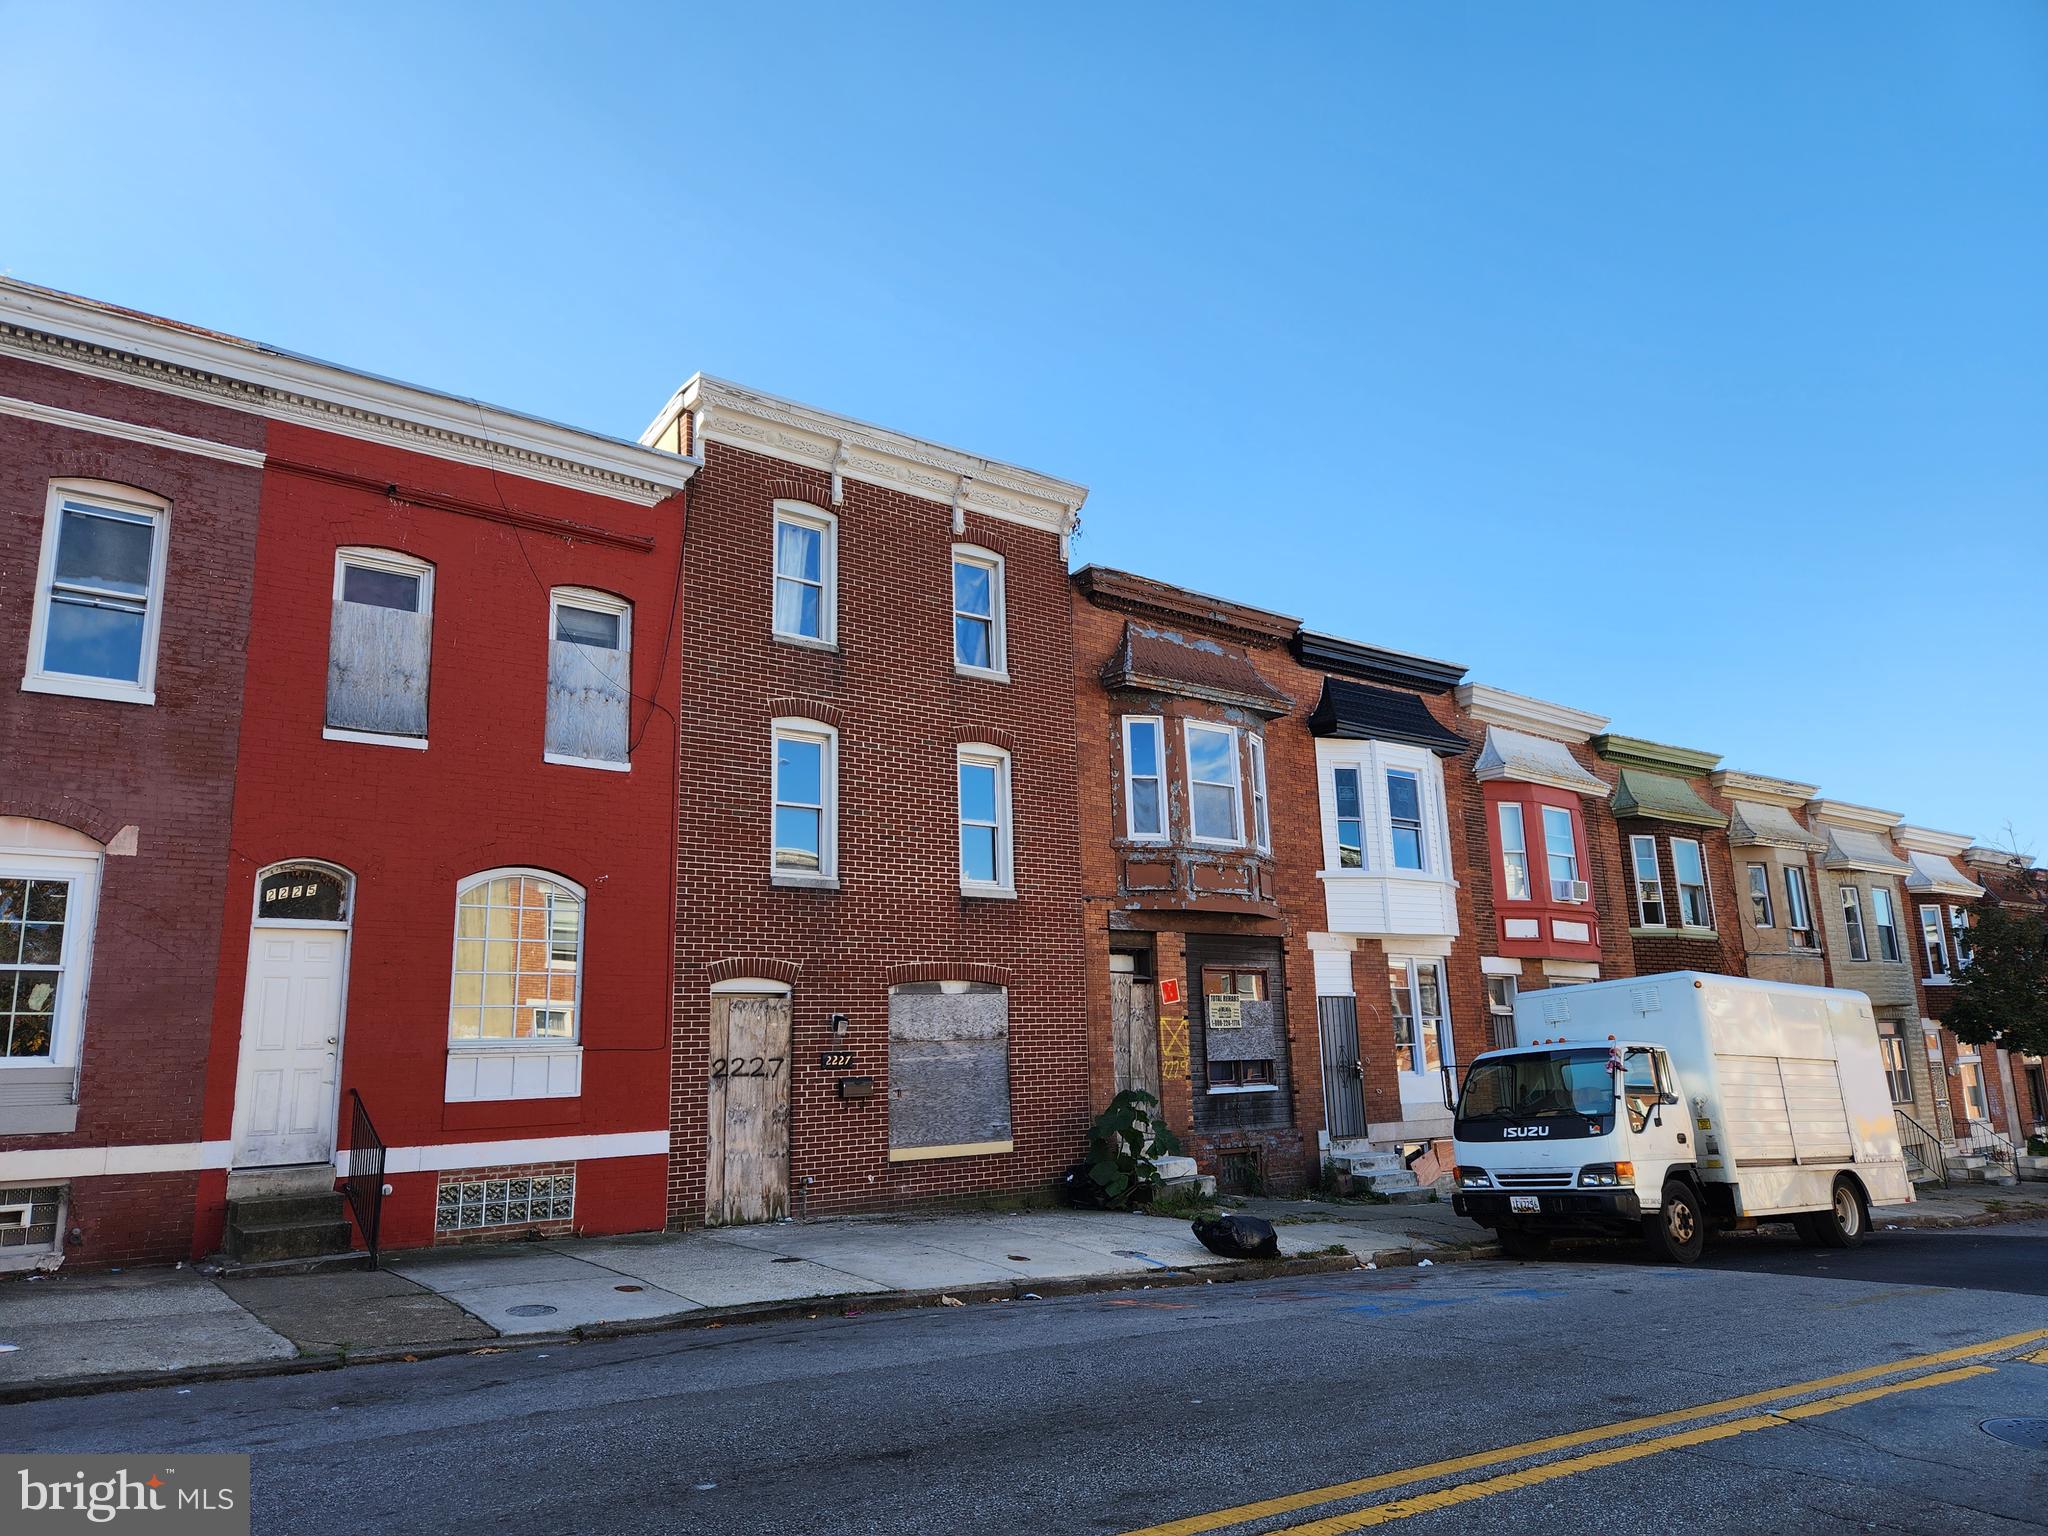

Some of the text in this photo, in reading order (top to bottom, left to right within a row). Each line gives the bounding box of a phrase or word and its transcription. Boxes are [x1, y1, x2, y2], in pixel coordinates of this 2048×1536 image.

[267, 885, 316, 901] 2225
[712, 1057, 785, 1080] 2227
[826, 1055, 852, 1066] 2227
[1162, 1060, 1189, 1080] 2229
[1503, 1126, 1549, 1138] ISUZU
